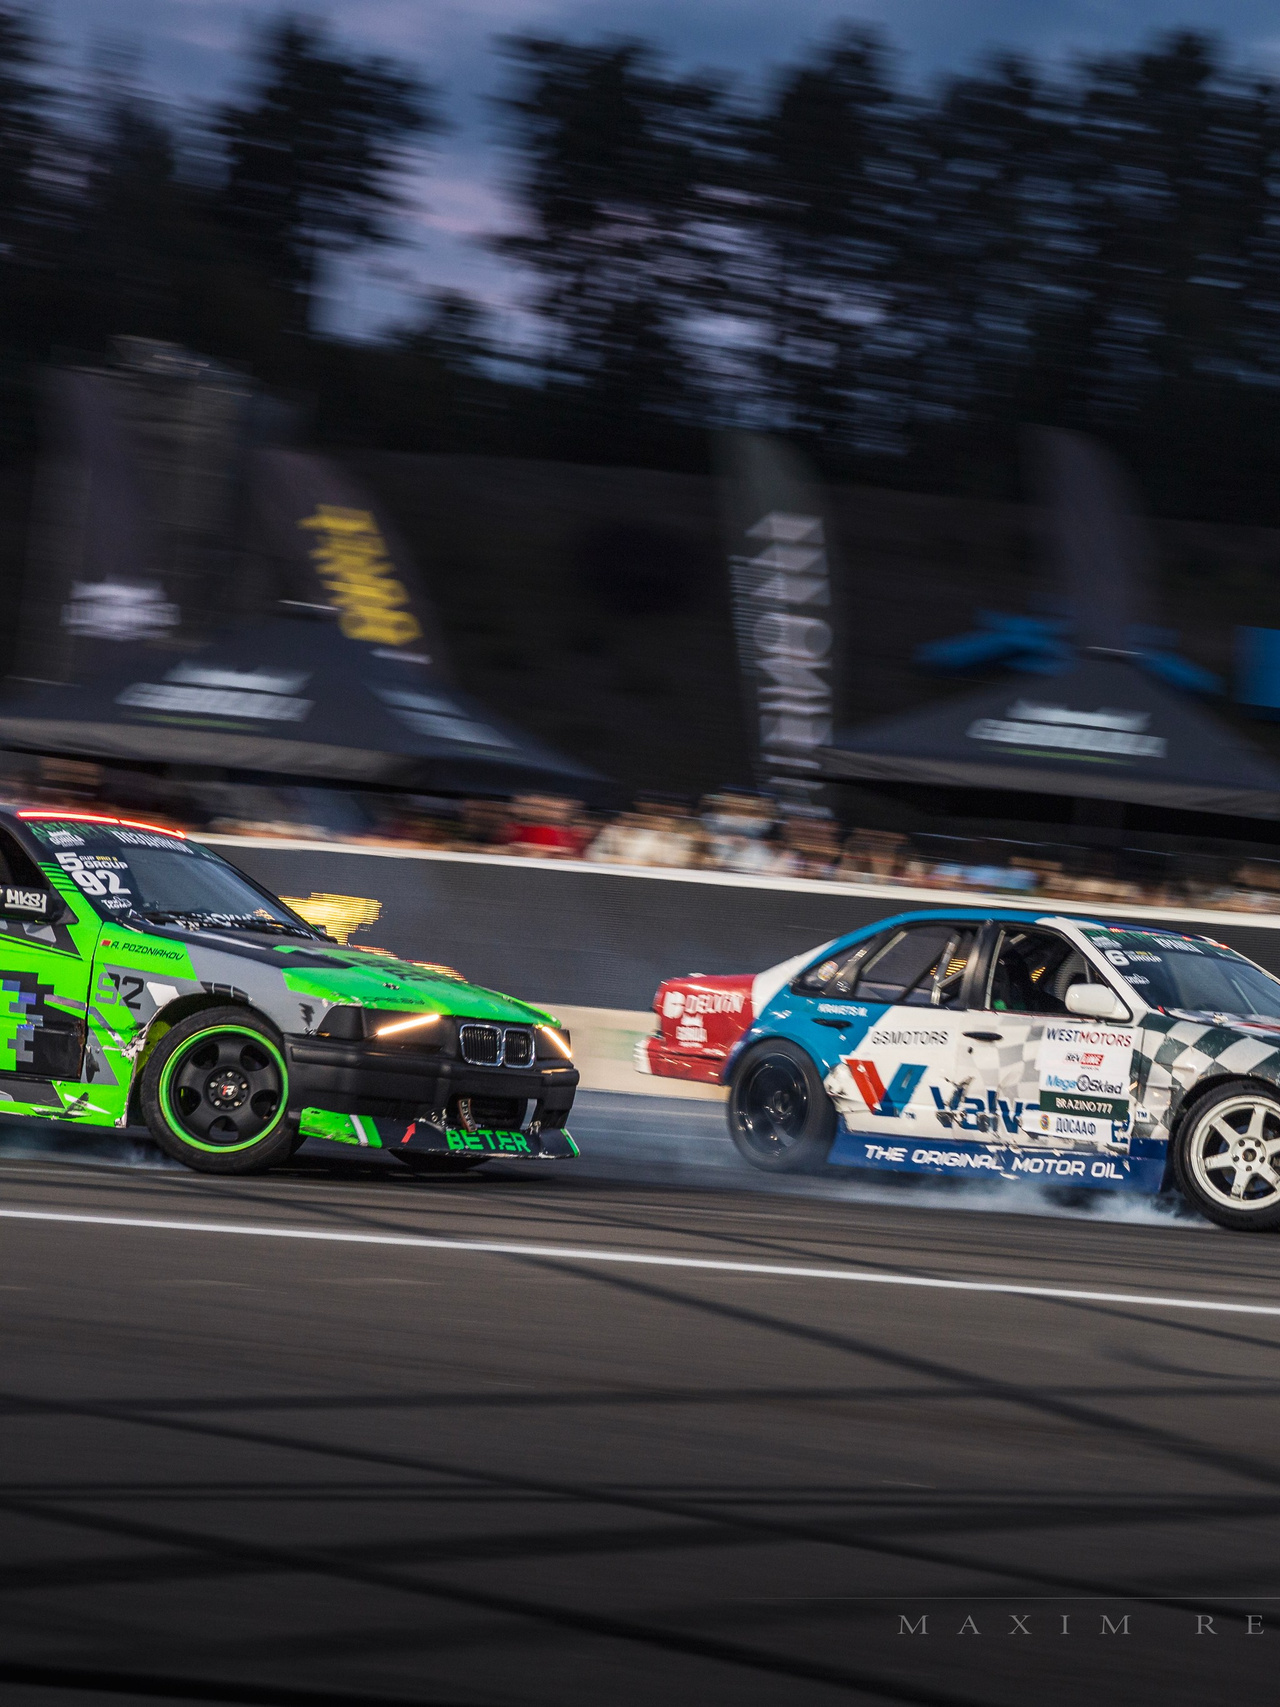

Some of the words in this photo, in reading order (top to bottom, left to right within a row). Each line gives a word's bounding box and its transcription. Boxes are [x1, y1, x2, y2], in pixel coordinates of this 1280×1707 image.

[54, 851, 84, 872] 5
[83, 860, 129, 870] GROUP
[71, 869, 132, 896] 92
[95, 972, 144, 1009] 92
[1046, 1027, 1132, 1048] WESTMOTORS
[1055, 1097, 1113, 1115] BRAZINO777
[1055, 1117, 1097, 1136] ДОСААФ
[445, 1129, 531, 1153] BETER
[865, 1144, 908, 1162] THE
[912, 1149, 1004, 1171] ORIGINAL
[1011, 1156, 1085, 1177] MOTOR
[1091, 1161, 1124, 1180] OIL
